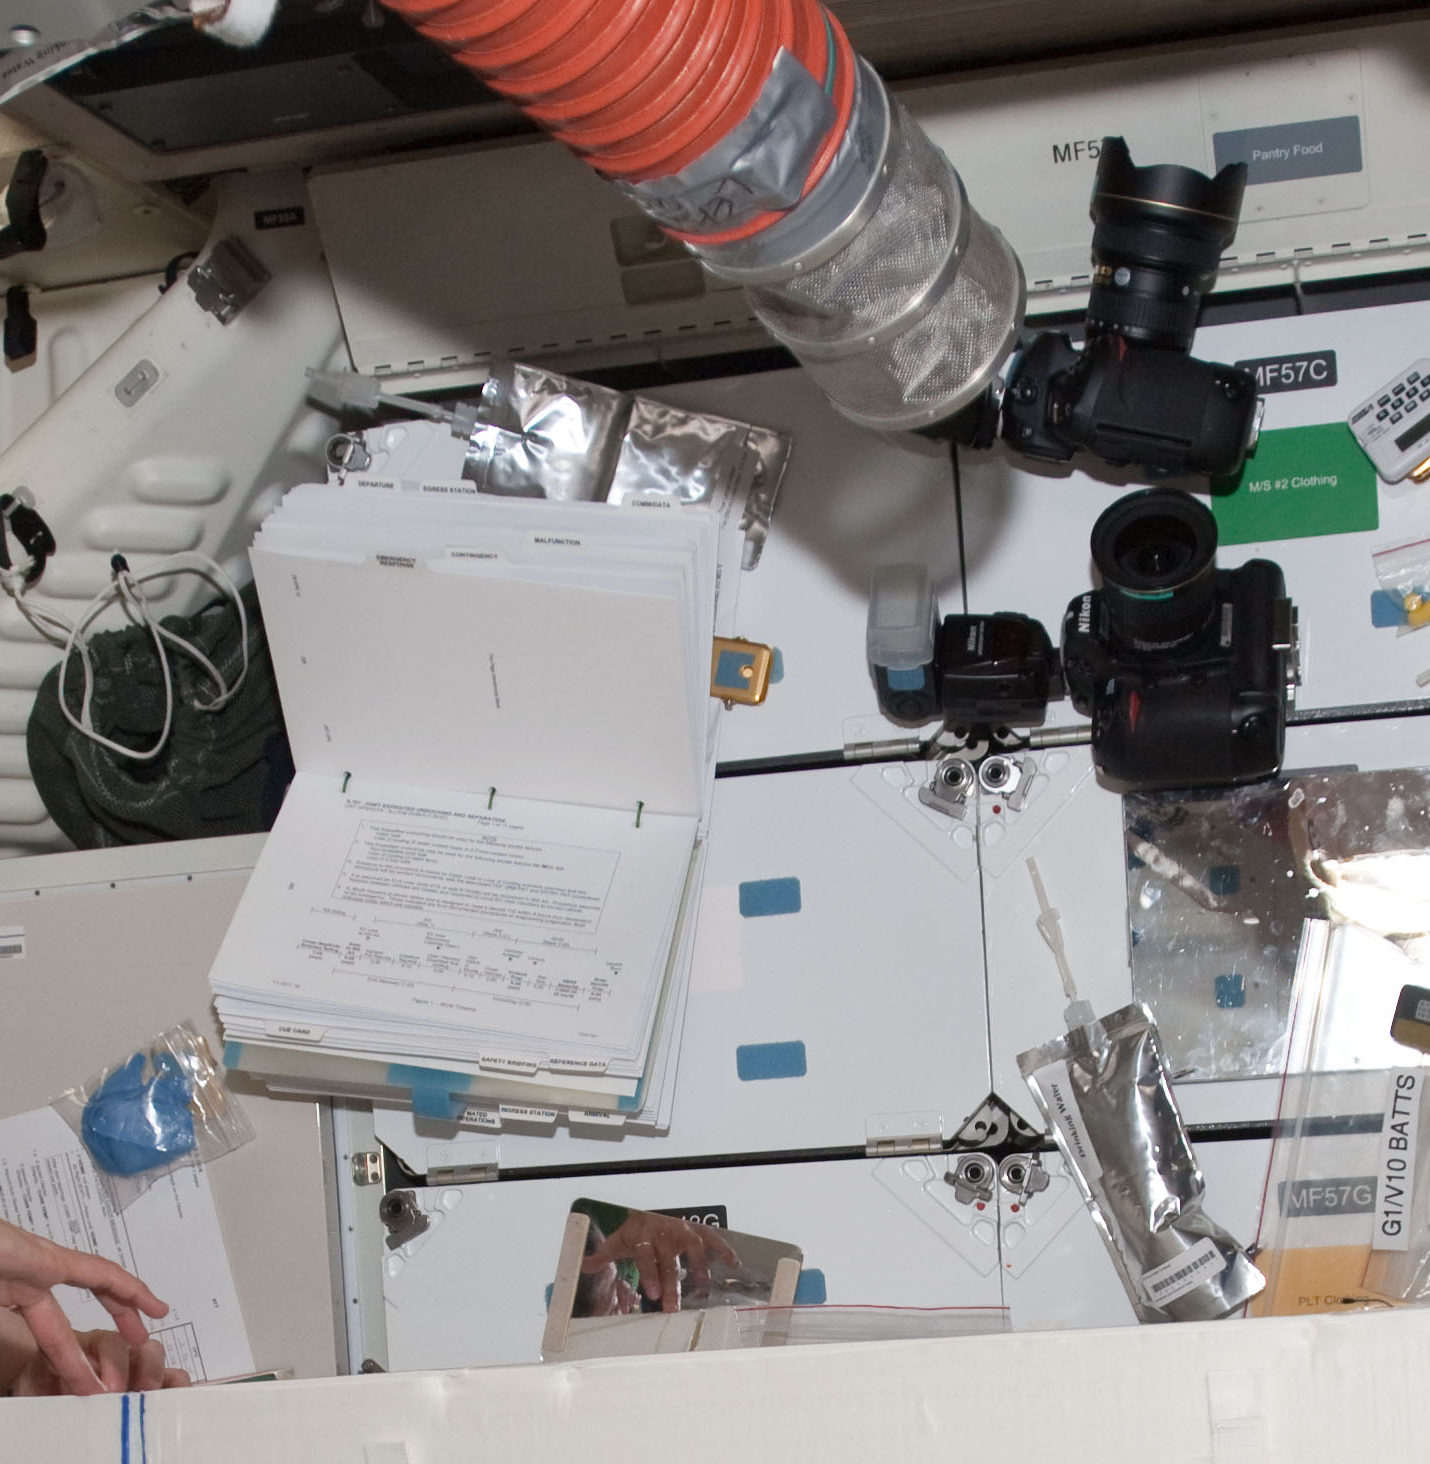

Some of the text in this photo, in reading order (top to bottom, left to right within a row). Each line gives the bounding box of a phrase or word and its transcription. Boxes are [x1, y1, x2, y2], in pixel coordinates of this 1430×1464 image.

[1252, 142, 1323, 161] Pantry Food
[358, 479, 394, 489] DEPARTURE
[1249, 474, 1338, 493] M/S #2 Clothing
[534, 536, 581, 546] MALFUNCTION
[1078, 595, 1092, 633] Nikon
[1050, 1083, 1087, 1158] Drinking Water
[1382, 1074, 1416, 1236] G1/V10 BATTS
[1291, 1185, 1371, 1208] MF57G
